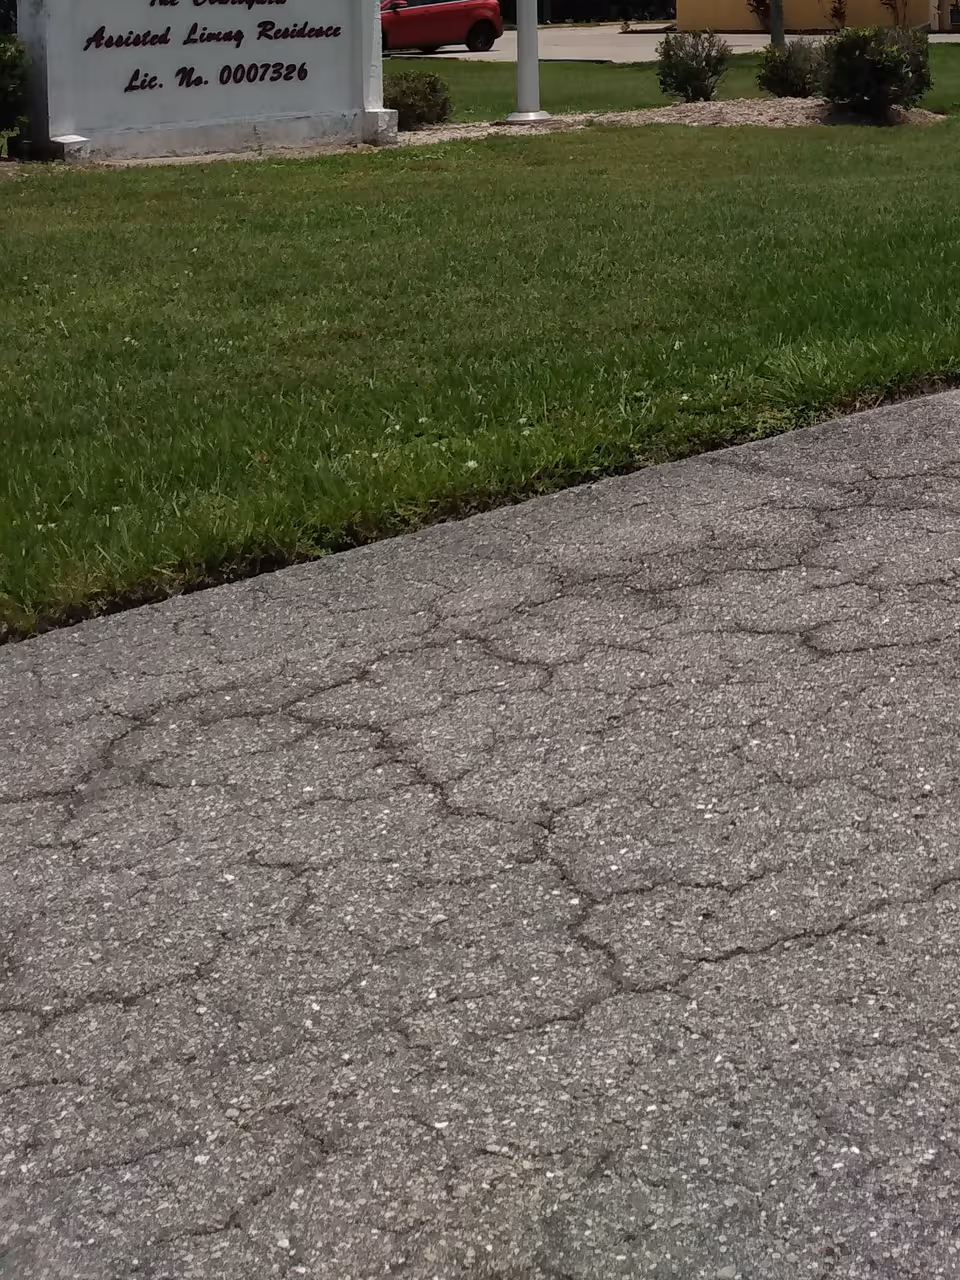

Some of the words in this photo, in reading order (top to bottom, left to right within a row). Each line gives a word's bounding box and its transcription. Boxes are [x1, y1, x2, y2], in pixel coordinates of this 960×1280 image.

[83, 26, 171, 51] Assisted
[256, 21, 341, 40] Residence
[124, 69, 163, 93] Lic.
[175, 66, 208, 88] No.
[219, 62, 308, 85] 0007326
